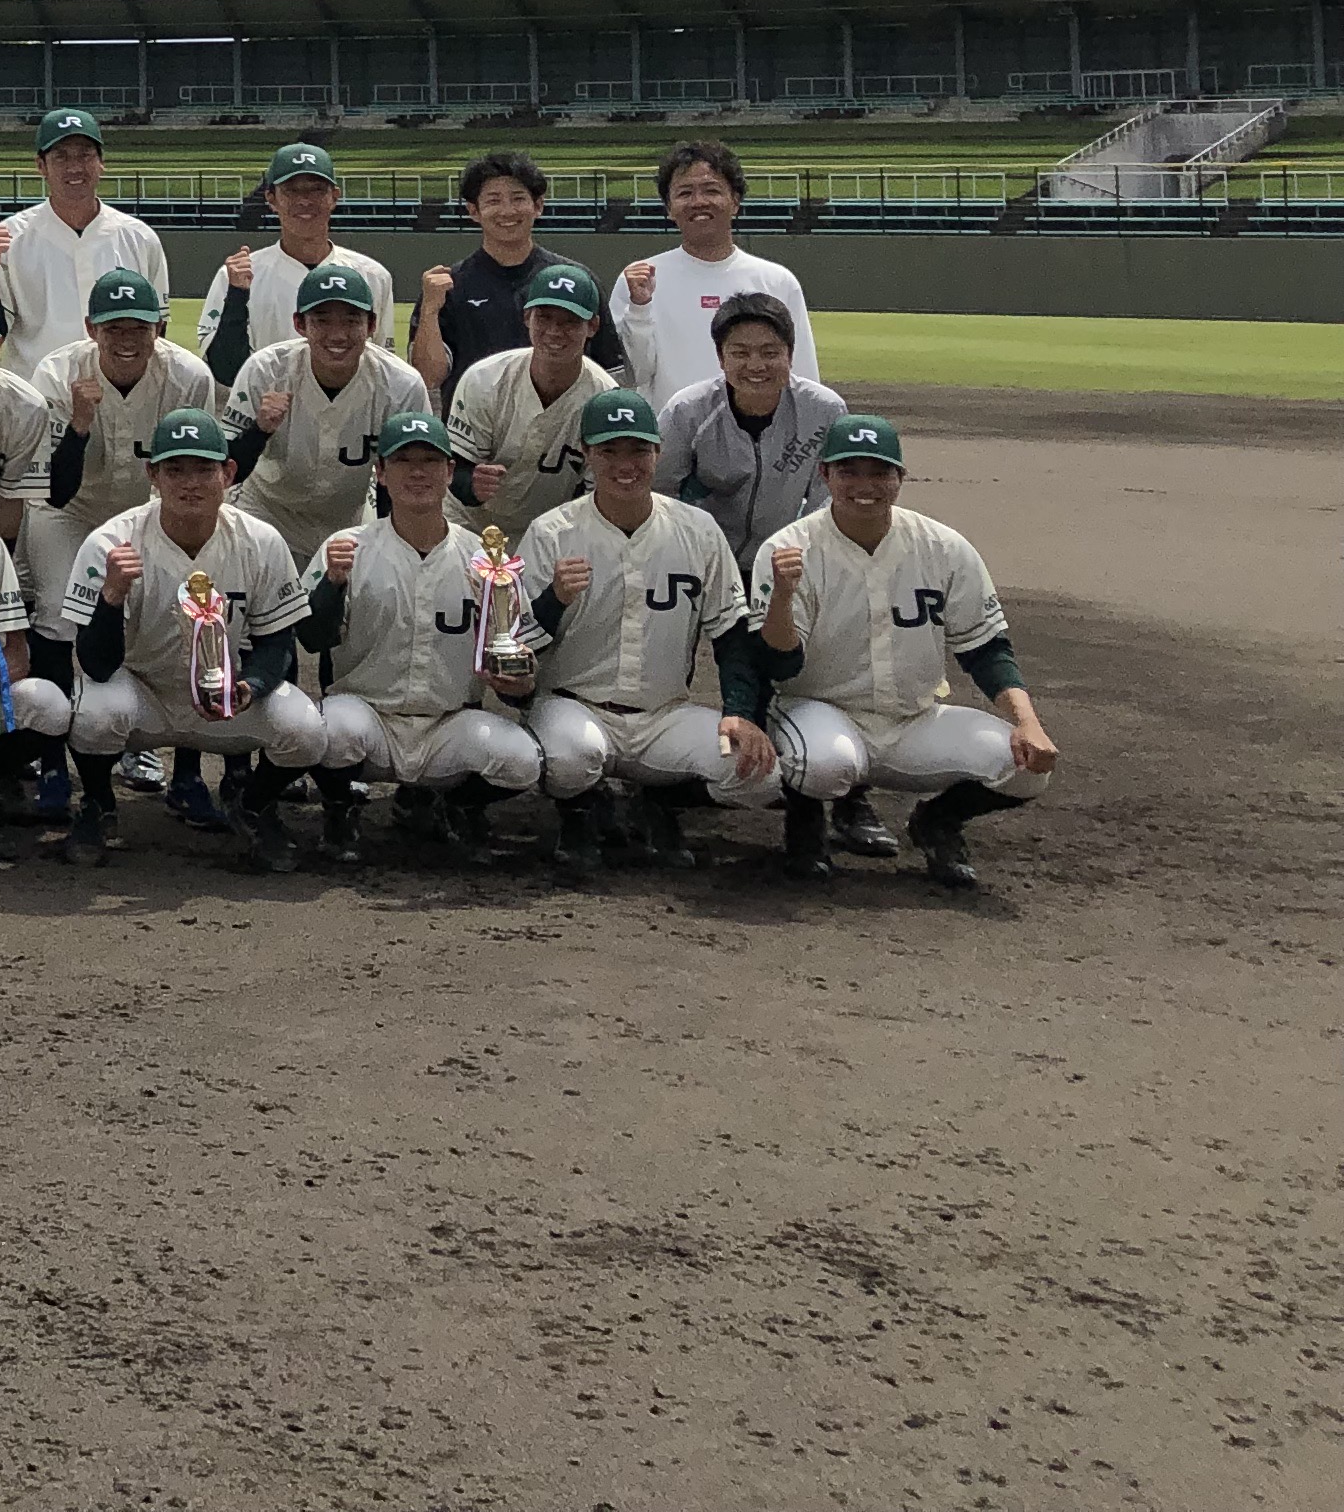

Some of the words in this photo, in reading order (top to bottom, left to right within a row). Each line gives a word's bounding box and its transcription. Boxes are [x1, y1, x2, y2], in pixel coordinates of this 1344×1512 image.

[57, 115, 83, 128] JR
[291, 153, 317, 165] JR
[319, 276, 347, 290] JR
[548, 277, 576, 294] JR
[109, 286, 136, 300] JR
[607, 408, 636, 423] JR
[171, 425, 200, 440] JR
[402, 419, 429, 433] JR
[848, 428, 878, 445] JR
[772, 432, 804, 473] EAST
[788, 425, 828, 474] JAPAN
[71, 583, 98, 602] TOKY
[277, 582, 295, 600] EAST
[646, 573, 702, 612] JR
[892, 588, 945, 629] JR
